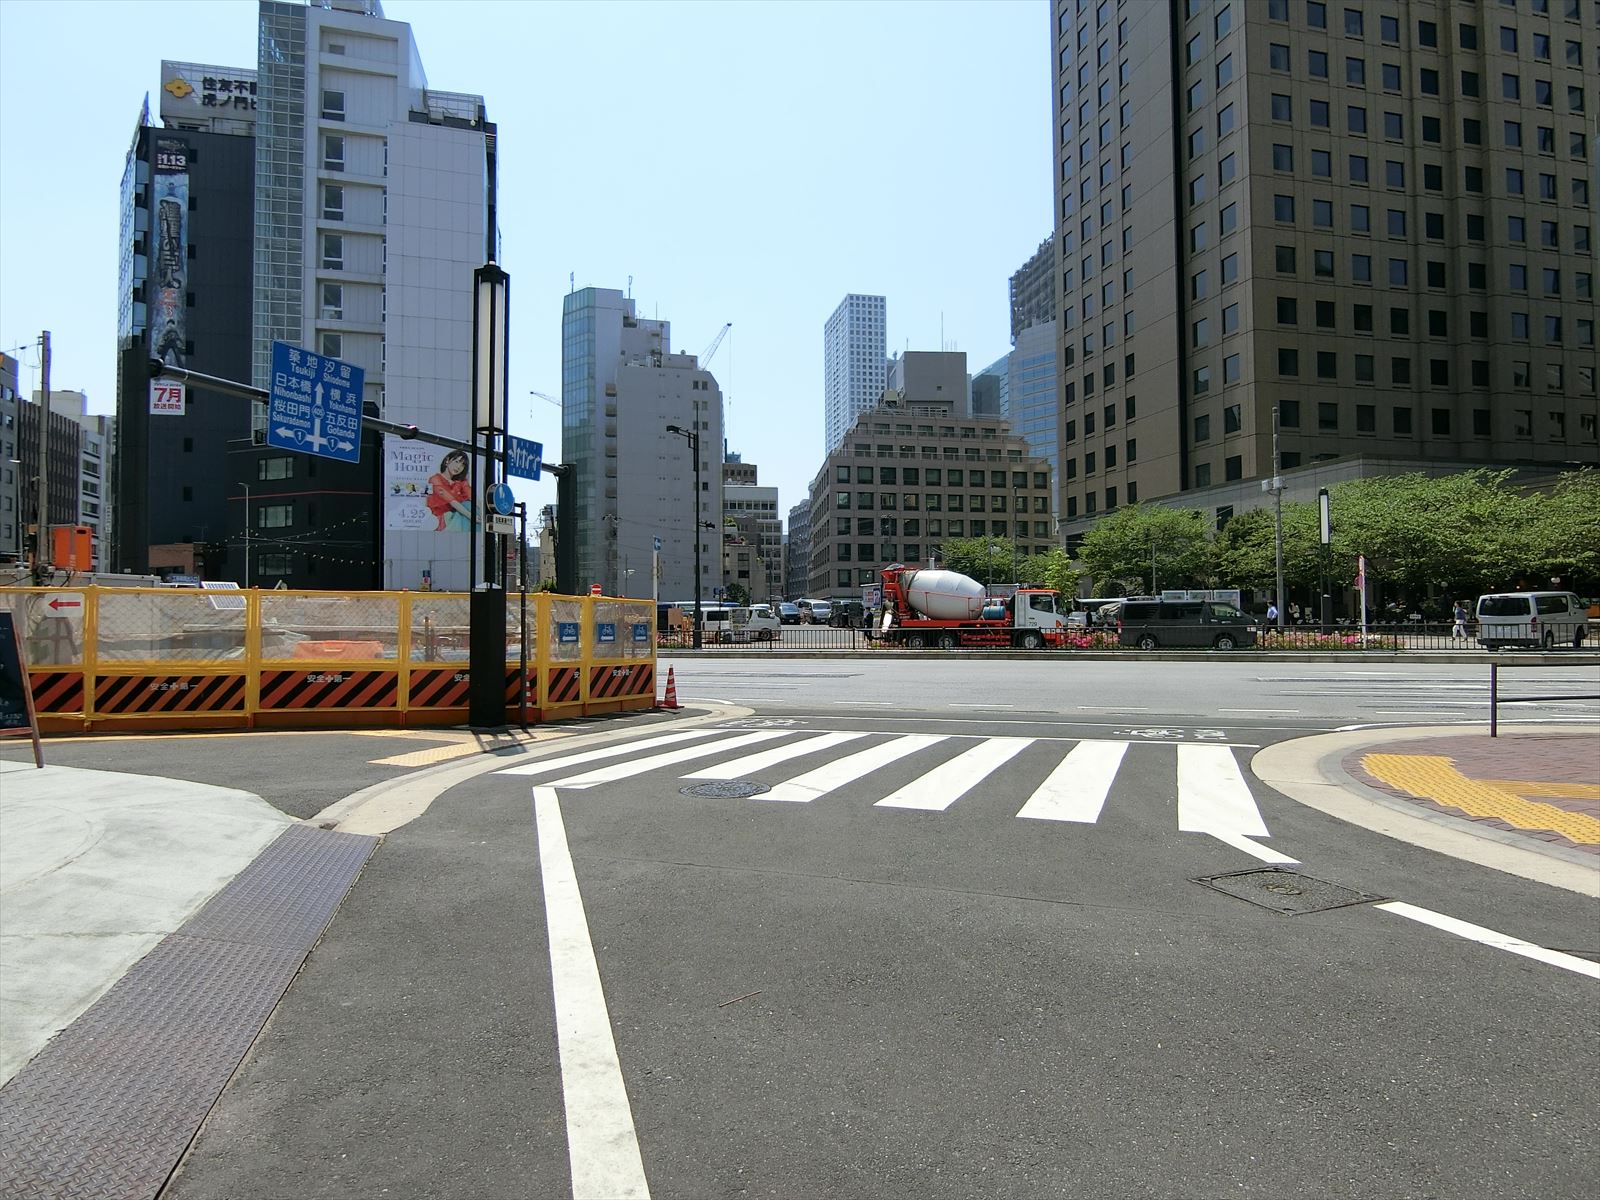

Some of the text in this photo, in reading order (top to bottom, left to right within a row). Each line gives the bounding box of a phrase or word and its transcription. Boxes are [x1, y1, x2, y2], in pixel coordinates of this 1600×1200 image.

[162, 154, 186, 166] 1.13
[289, 348, 318, 369] 築地
[290, 362, 316, 379] Tsukiji
[324, 360, 351, 378] 汐留
[276, 372, 312, 393] 日本橋
[323, 372, 351, 389] Shiodome
[154, 387, 182, 403] 7月
[274, 385, 312, 404] Nihonbashi
[330, 388, 357, 406] 横浜
[274, 398, 311, 419] 桜田門
[329, 399, 357, 416] Yokohama
[272, 411, 311, 429] Sakuradamon
[325, 411, 358, 430] 五反田
[327, 425, 355, 439] Gotanda
[391, 451, 434, 464] Magic
[394, 462, 432, 473] Hour
[398, 508, 426, 519] 4.25
